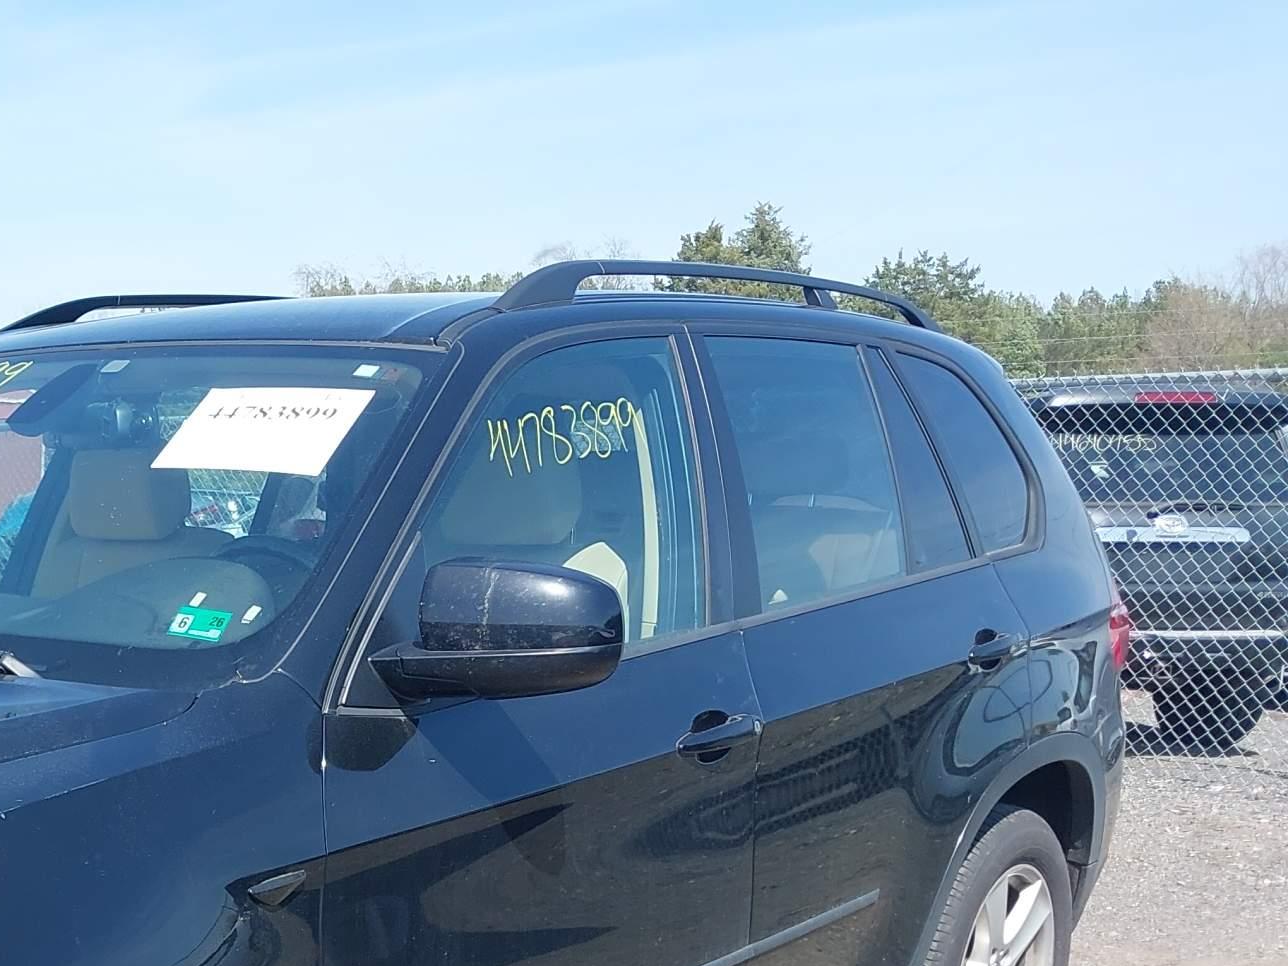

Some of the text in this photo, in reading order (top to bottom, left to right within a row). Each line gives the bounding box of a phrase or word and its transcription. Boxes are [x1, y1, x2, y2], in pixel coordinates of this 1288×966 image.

[208, 406, 338, 420] 44783899
[487, 397, 648, 477] 44783899
[178, 616, 226, 629] 6 26
